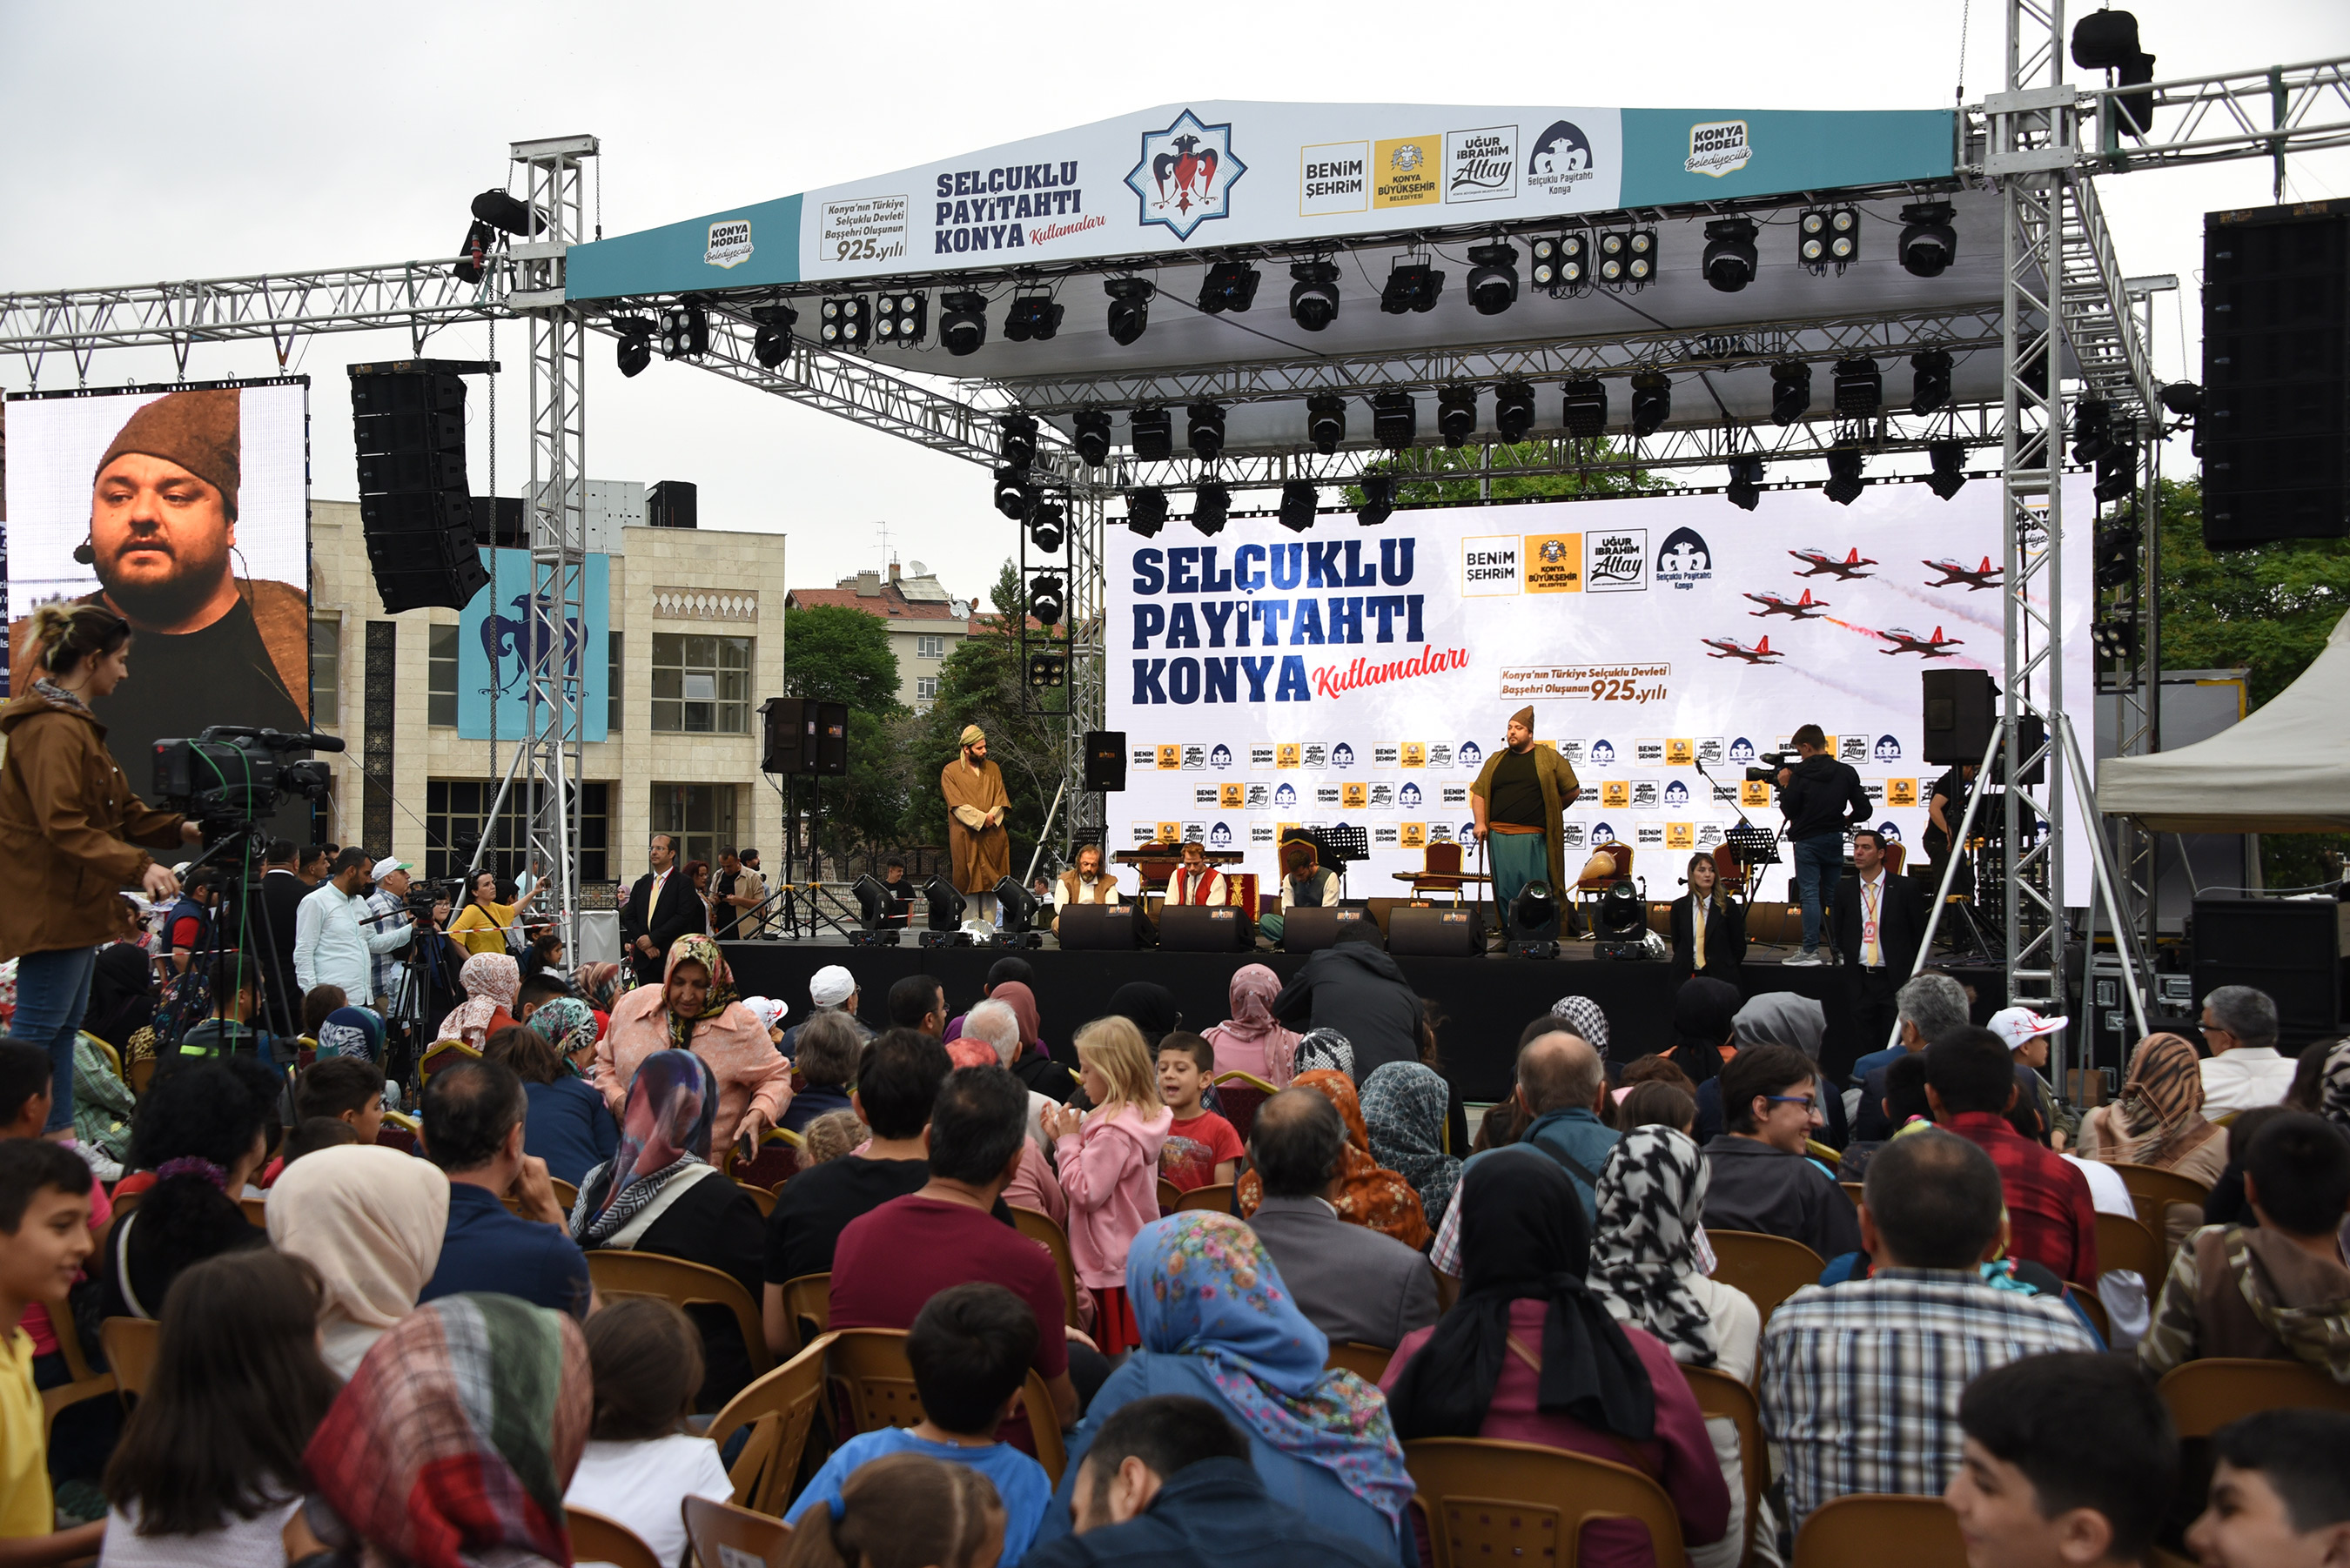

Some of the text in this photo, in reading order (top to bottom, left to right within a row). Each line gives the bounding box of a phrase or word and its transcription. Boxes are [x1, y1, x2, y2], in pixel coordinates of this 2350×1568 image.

[1695, 124, 1743, 143] KONYA
[1466, 136, 1500, 149] UĞUR
[1686, 147, 1751, 170] Belediyecilik
[937, 160, 1078, 198] SELÇUKLU
[1393, 174, 1420, 184] KONYA
[1450, 158, 1513, 191] Altay
[1528, 174, 1558, 187] Selçuklu
[1378, 182, 1435, 196] BÜYÜKŞEHİR
[1549, 186, 1571, 196] Konya
[872, 200, 904, 212] Türkiye
[836, 211, 904, 226] Selçuklu Devleti
[712, 224, 748, 238] KONYA
[825, 224, 903, 240] Başşehri Oluşunun
[1029, 214, 1107, 245] Kutlamaları
[935, 223, 1024, 254] KONYA
[705, 244, 753, 262] Belediyecilik
[1602, 536, 1632, 546] UĞUR
[1133, 538, 1415, 596] SELÇUKLU
[1590, 555, 1642, 582] Altay
[1132, 655, 1311, 704] KONYA
[1312, 644, 1469, 700] Kutlamaları
[1551, 669, 1587, 680] Türkiye
[1588, 668, 1628, 680] Selçuklu
[1631, 667, 1667, 676] Devleti
[1502, 684, 1542, 696] Başşehri
[1545, 684, 1589, 695] Oluşunun
